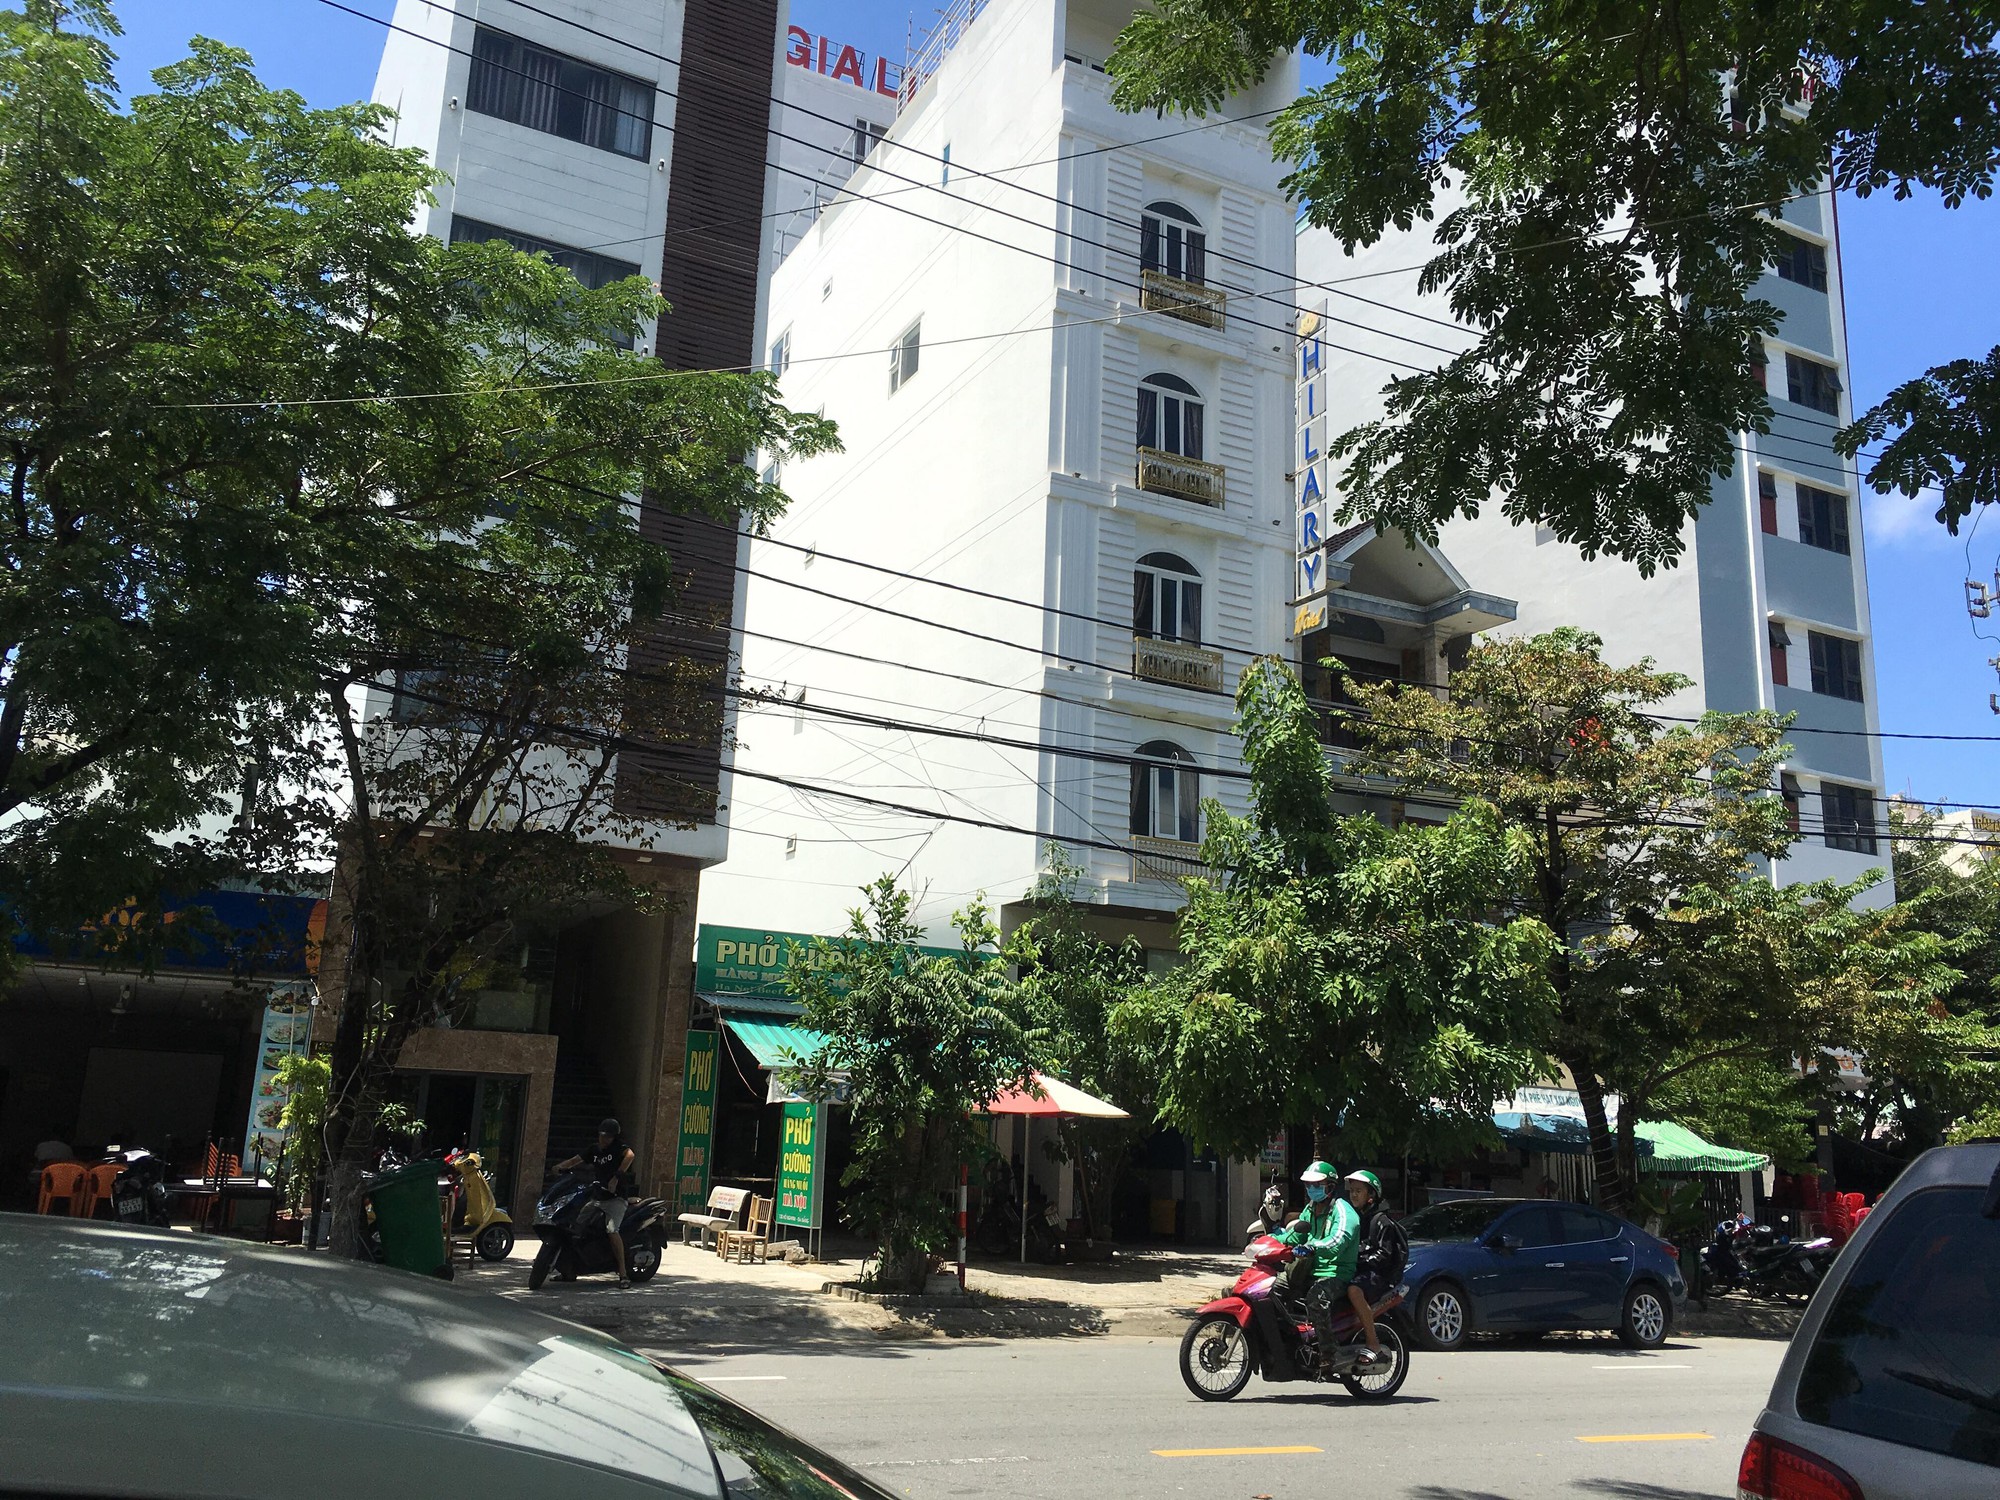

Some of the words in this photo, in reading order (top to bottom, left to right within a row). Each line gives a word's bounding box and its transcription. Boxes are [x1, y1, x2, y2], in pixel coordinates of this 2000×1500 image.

[786, 25, 864, 87] GIA
[875, 55, 922, 103] L
[1302, 336, 1322, 592] HILARY
[716, 934, 781, 967] PHỞ
[688, 1034, 714, 1092] PHỞ
[683, 1097, 711, 1134] CƯỜNG
[785, 1107, 813, 1145] PHỞ
[783, 1149, 812, 1174] CƯỜNG
